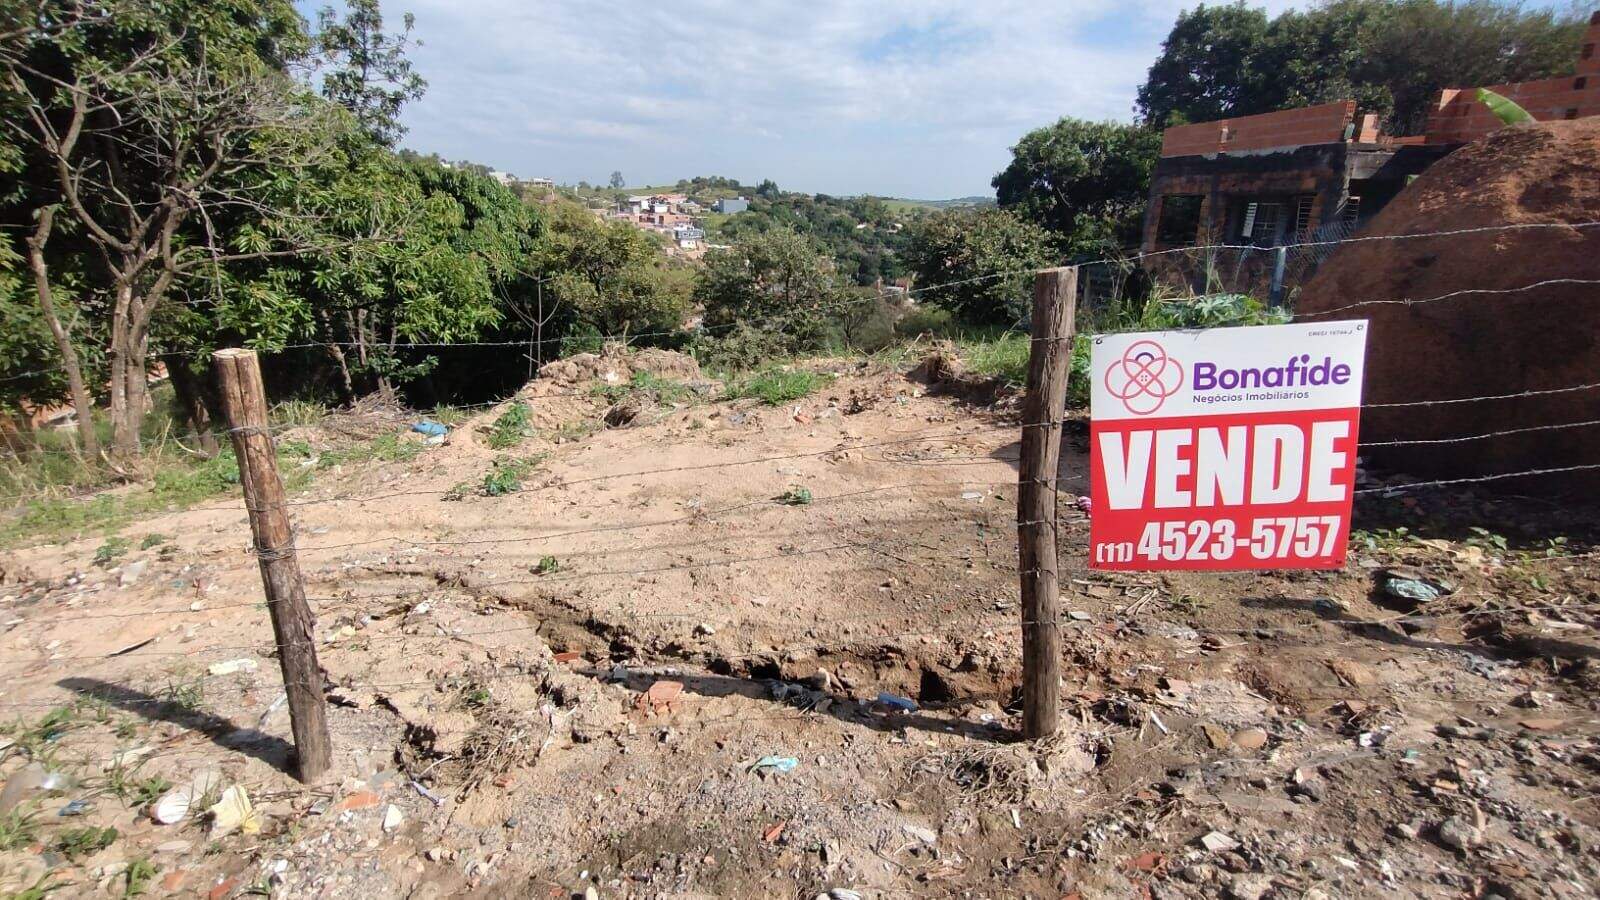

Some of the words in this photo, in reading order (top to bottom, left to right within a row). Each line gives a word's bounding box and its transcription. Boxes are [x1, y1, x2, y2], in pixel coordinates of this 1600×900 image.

[1193, 354, 1351, 391] Bonafide
[1193, 393, 1243, 404] Negócios
[1246, 390, 1309, 402] Imobiliários
[1098, 420, 1350, 510] VENDE
[1096, 542, 1133, 563] (11)
[1137, 515, 1341, 562] 4523-5757
